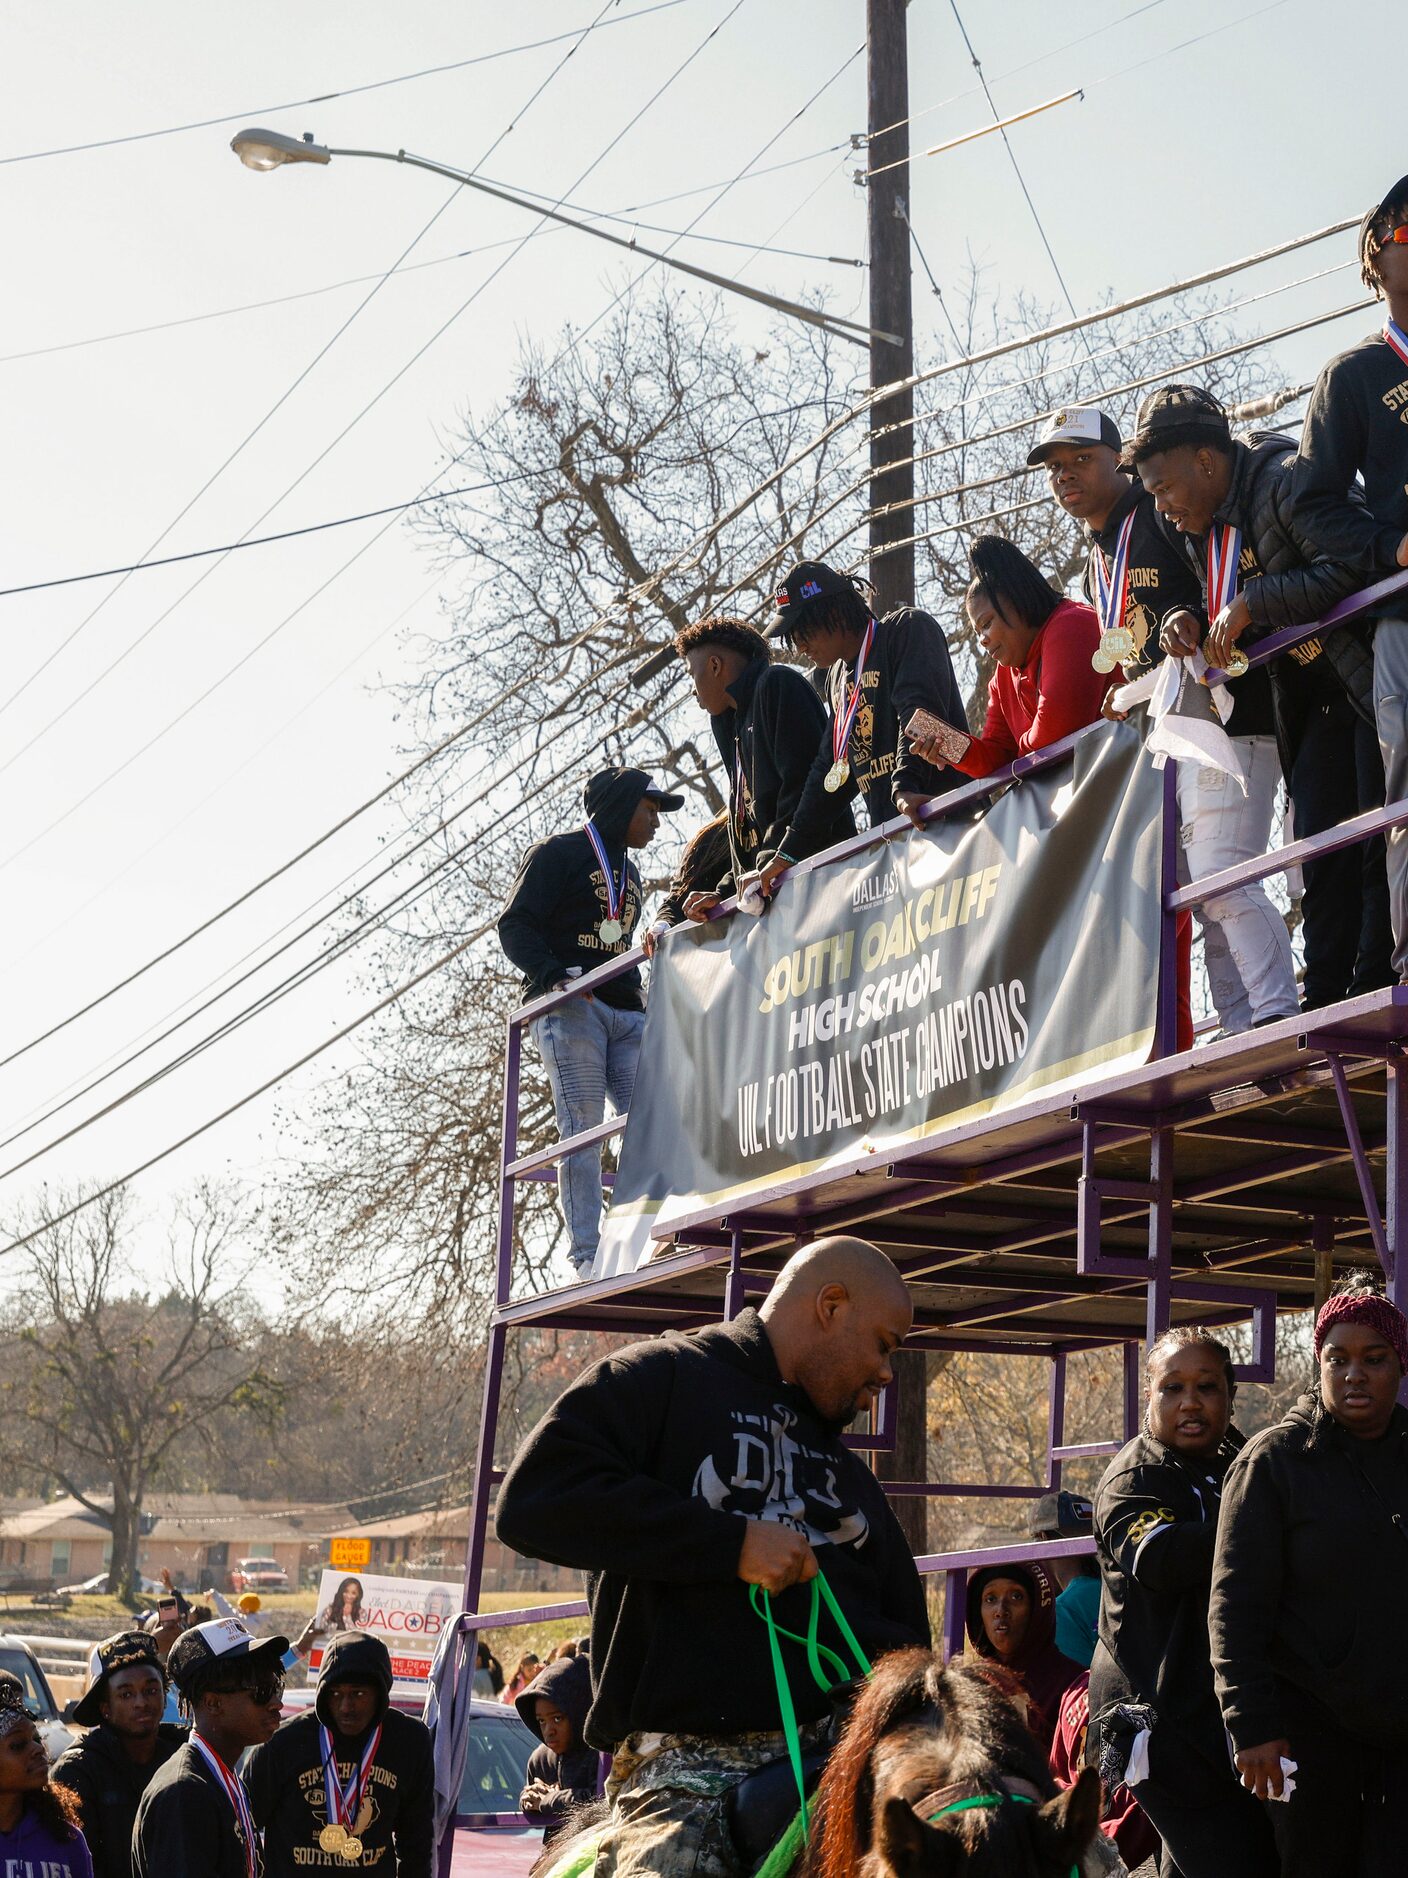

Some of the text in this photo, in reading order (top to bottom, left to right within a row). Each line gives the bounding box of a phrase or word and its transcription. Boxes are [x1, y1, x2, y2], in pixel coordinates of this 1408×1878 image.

[1127, 568, 1159, 589] PIONS
[869, 752, 895, 779] CLIFF
[852, 870, 895, 906] DALLAS
[759, 864, 1003, 1013] SOUTH OAK CLIFF
[788, 948, 942, 1053] HIGH SCHOOL
[738, 978, 1029, 1158] UIL FOOTBALL STATE CHAMPIONS
[406, 1661, 431, 1670] PEAC
[299, 1762, 398, 1790] STAT CHPIONS
